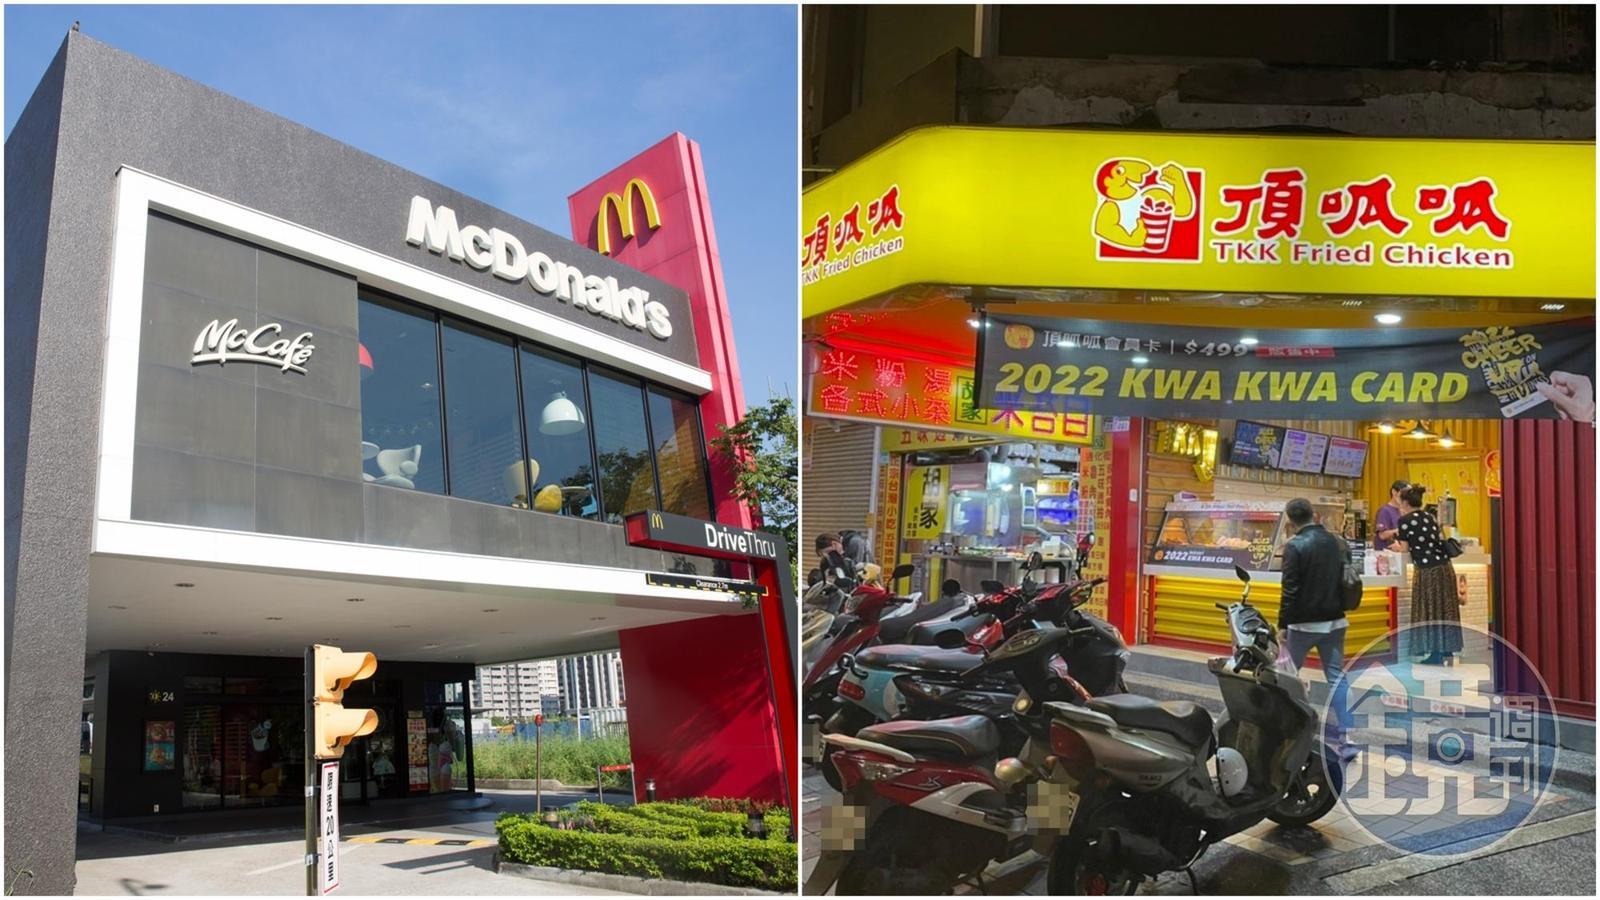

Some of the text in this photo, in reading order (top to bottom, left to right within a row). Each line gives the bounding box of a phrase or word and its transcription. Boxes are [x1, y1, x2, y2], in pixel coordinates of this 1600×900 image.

[1213, 170, 1508, 239] 頂呱呱
[802, 186, 903, 267] 頂呱呱
[405, 194, 673, 340] McDonald's
[823, 256, 850, 276] Fried
[853, 238, 903, 265] Chicken
[1212, 241, 1511, 267] TKK Fried Chicken
[190, 318, 316, 373] McCafé
[1042, 330, 1162, 353] 頂呱呱會員卡
[1184, 339, 1249, 357] $499
[995, 362, 1109, 396] 2022
[1118, 367, 1222, 400] KWA
[1233, 370, 1338, 402] KWA
[1350, 370, 1470, 403] CARD
[1164, 550, 1189, 561] 2022
[162, 691, 175, 702] 24
